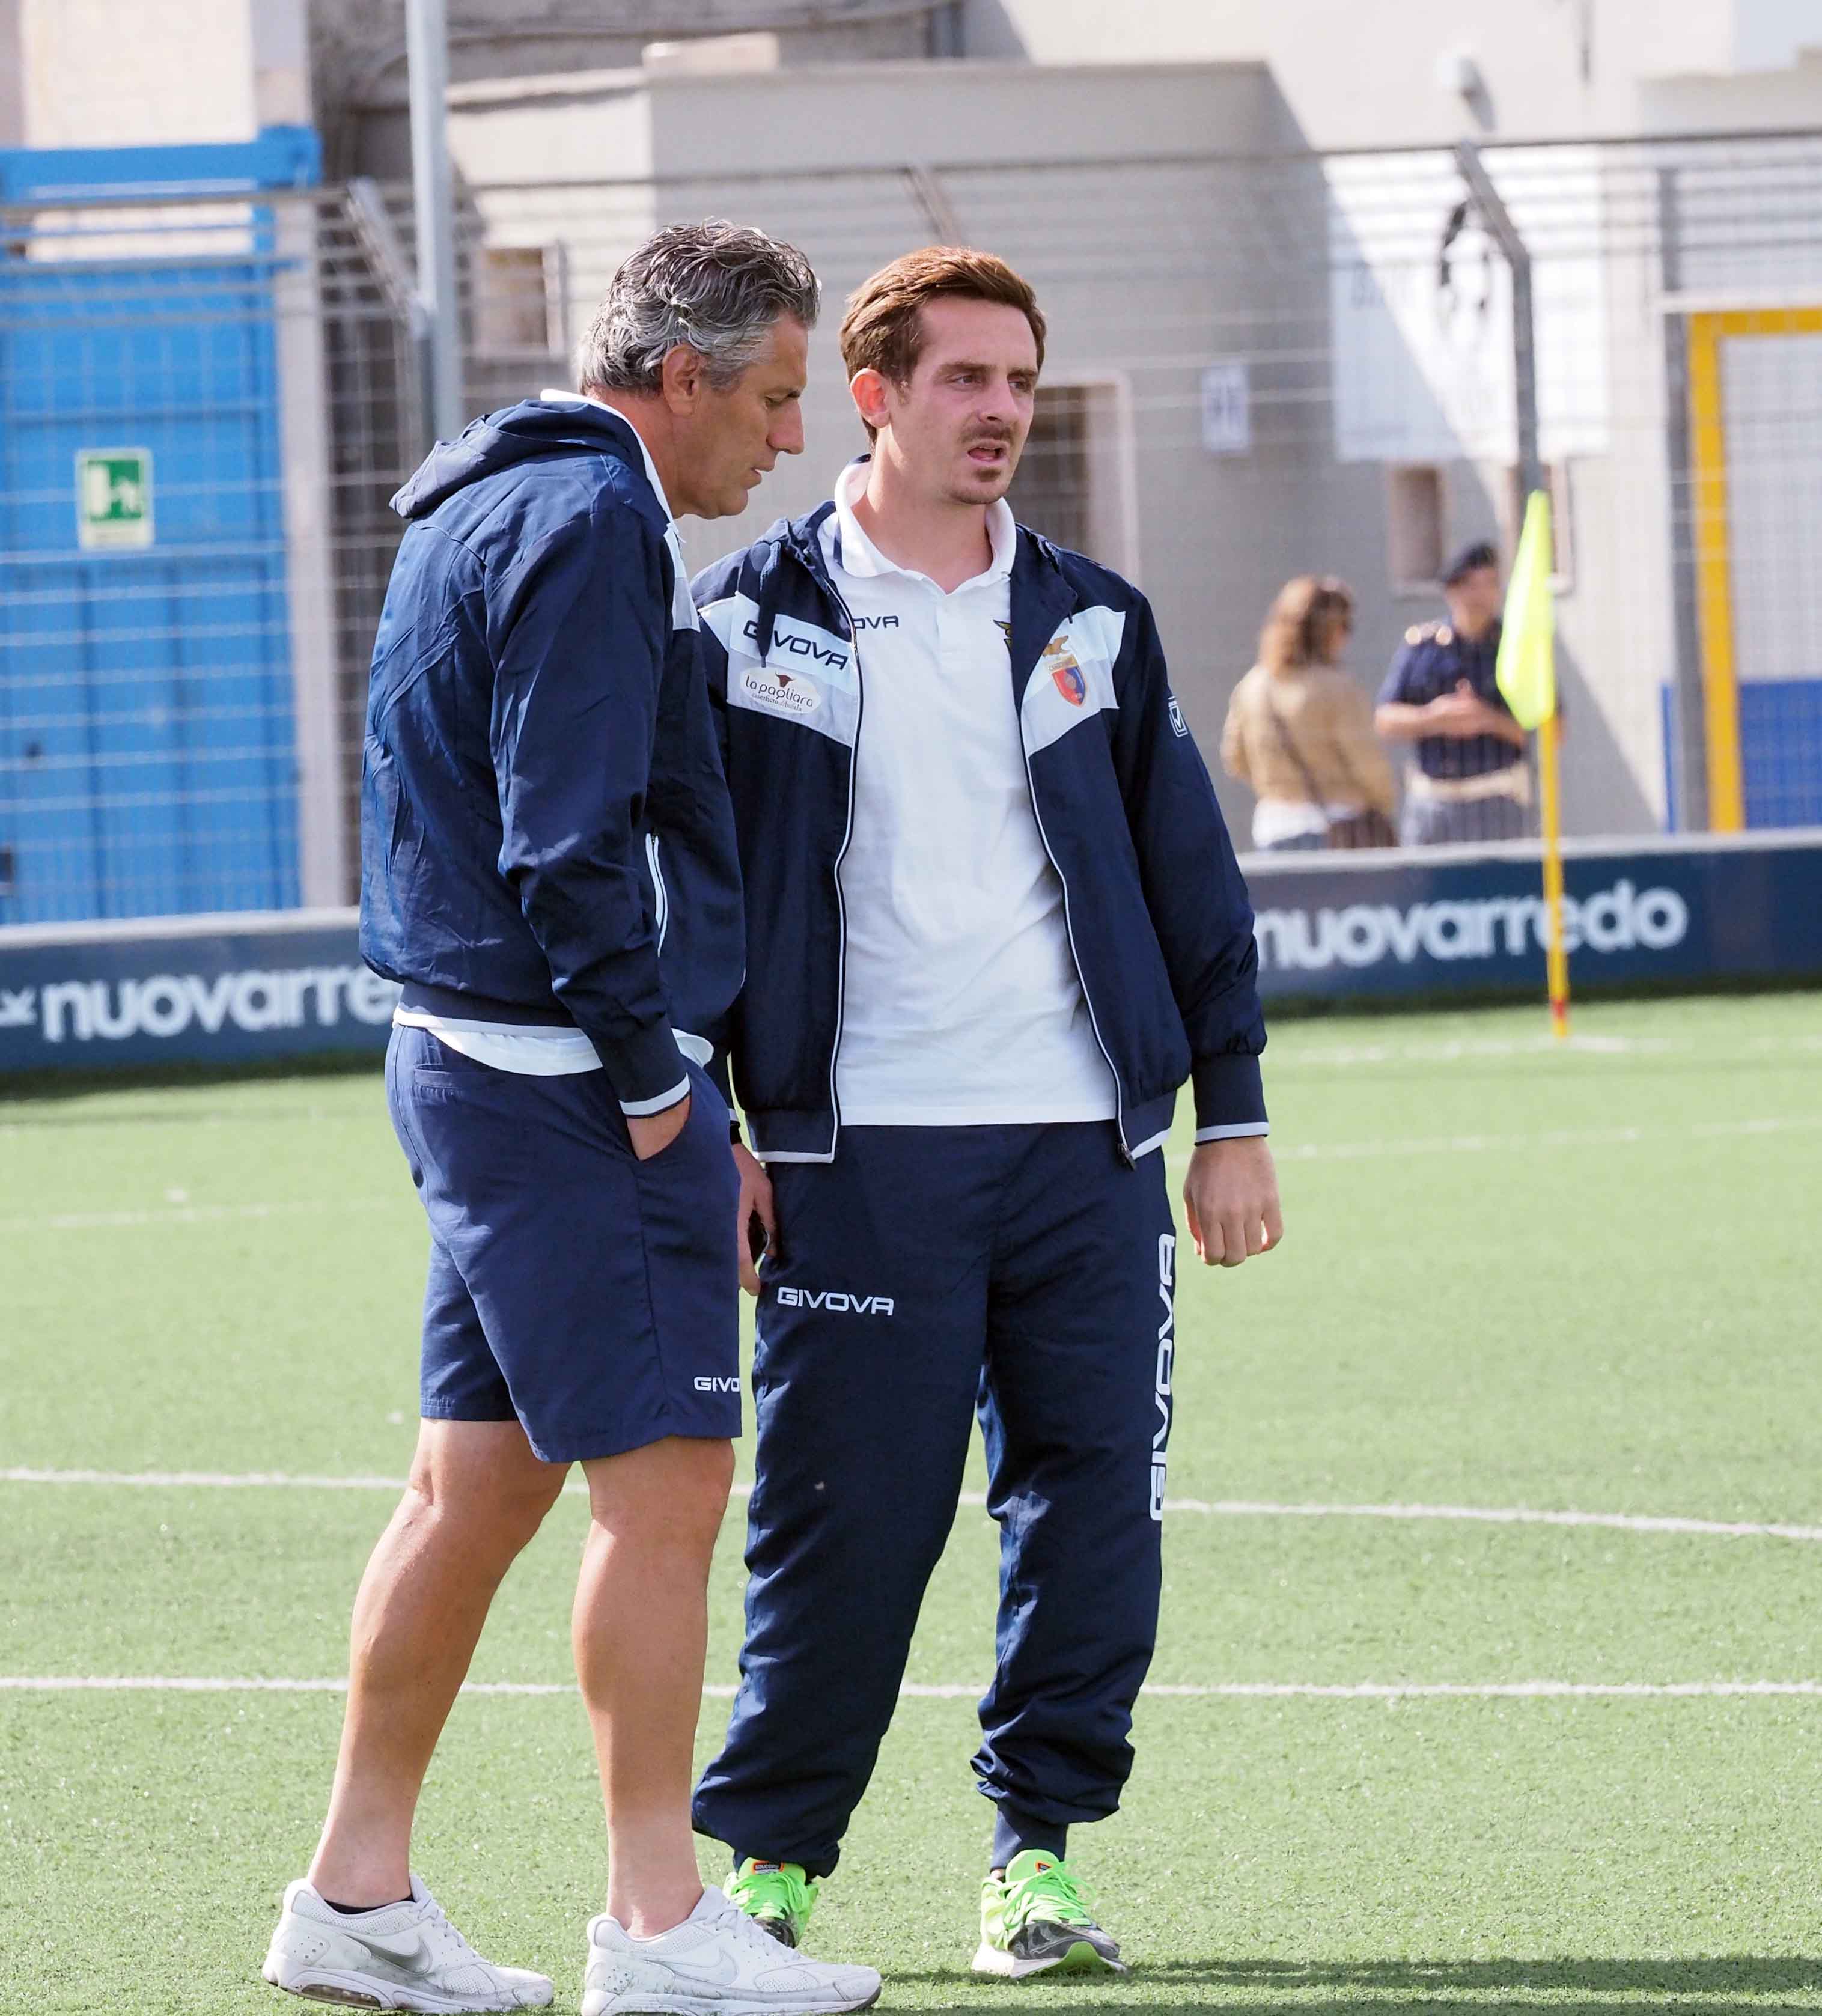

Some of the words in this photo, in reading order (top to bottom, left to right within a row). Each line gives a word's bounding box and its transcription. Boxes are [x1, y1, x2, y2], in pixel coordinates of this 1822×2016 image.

[743, 620, 849, 670] GVOVA
[745, 675, 757, 690] la
[758, 684, 813, 707] pagliara
[1252, 877, 1689, 970] nuovarredo
[777, 1287, 894, 1316] GIVOVA
[1148, 1233, 1175, 1521] GIVOVA
